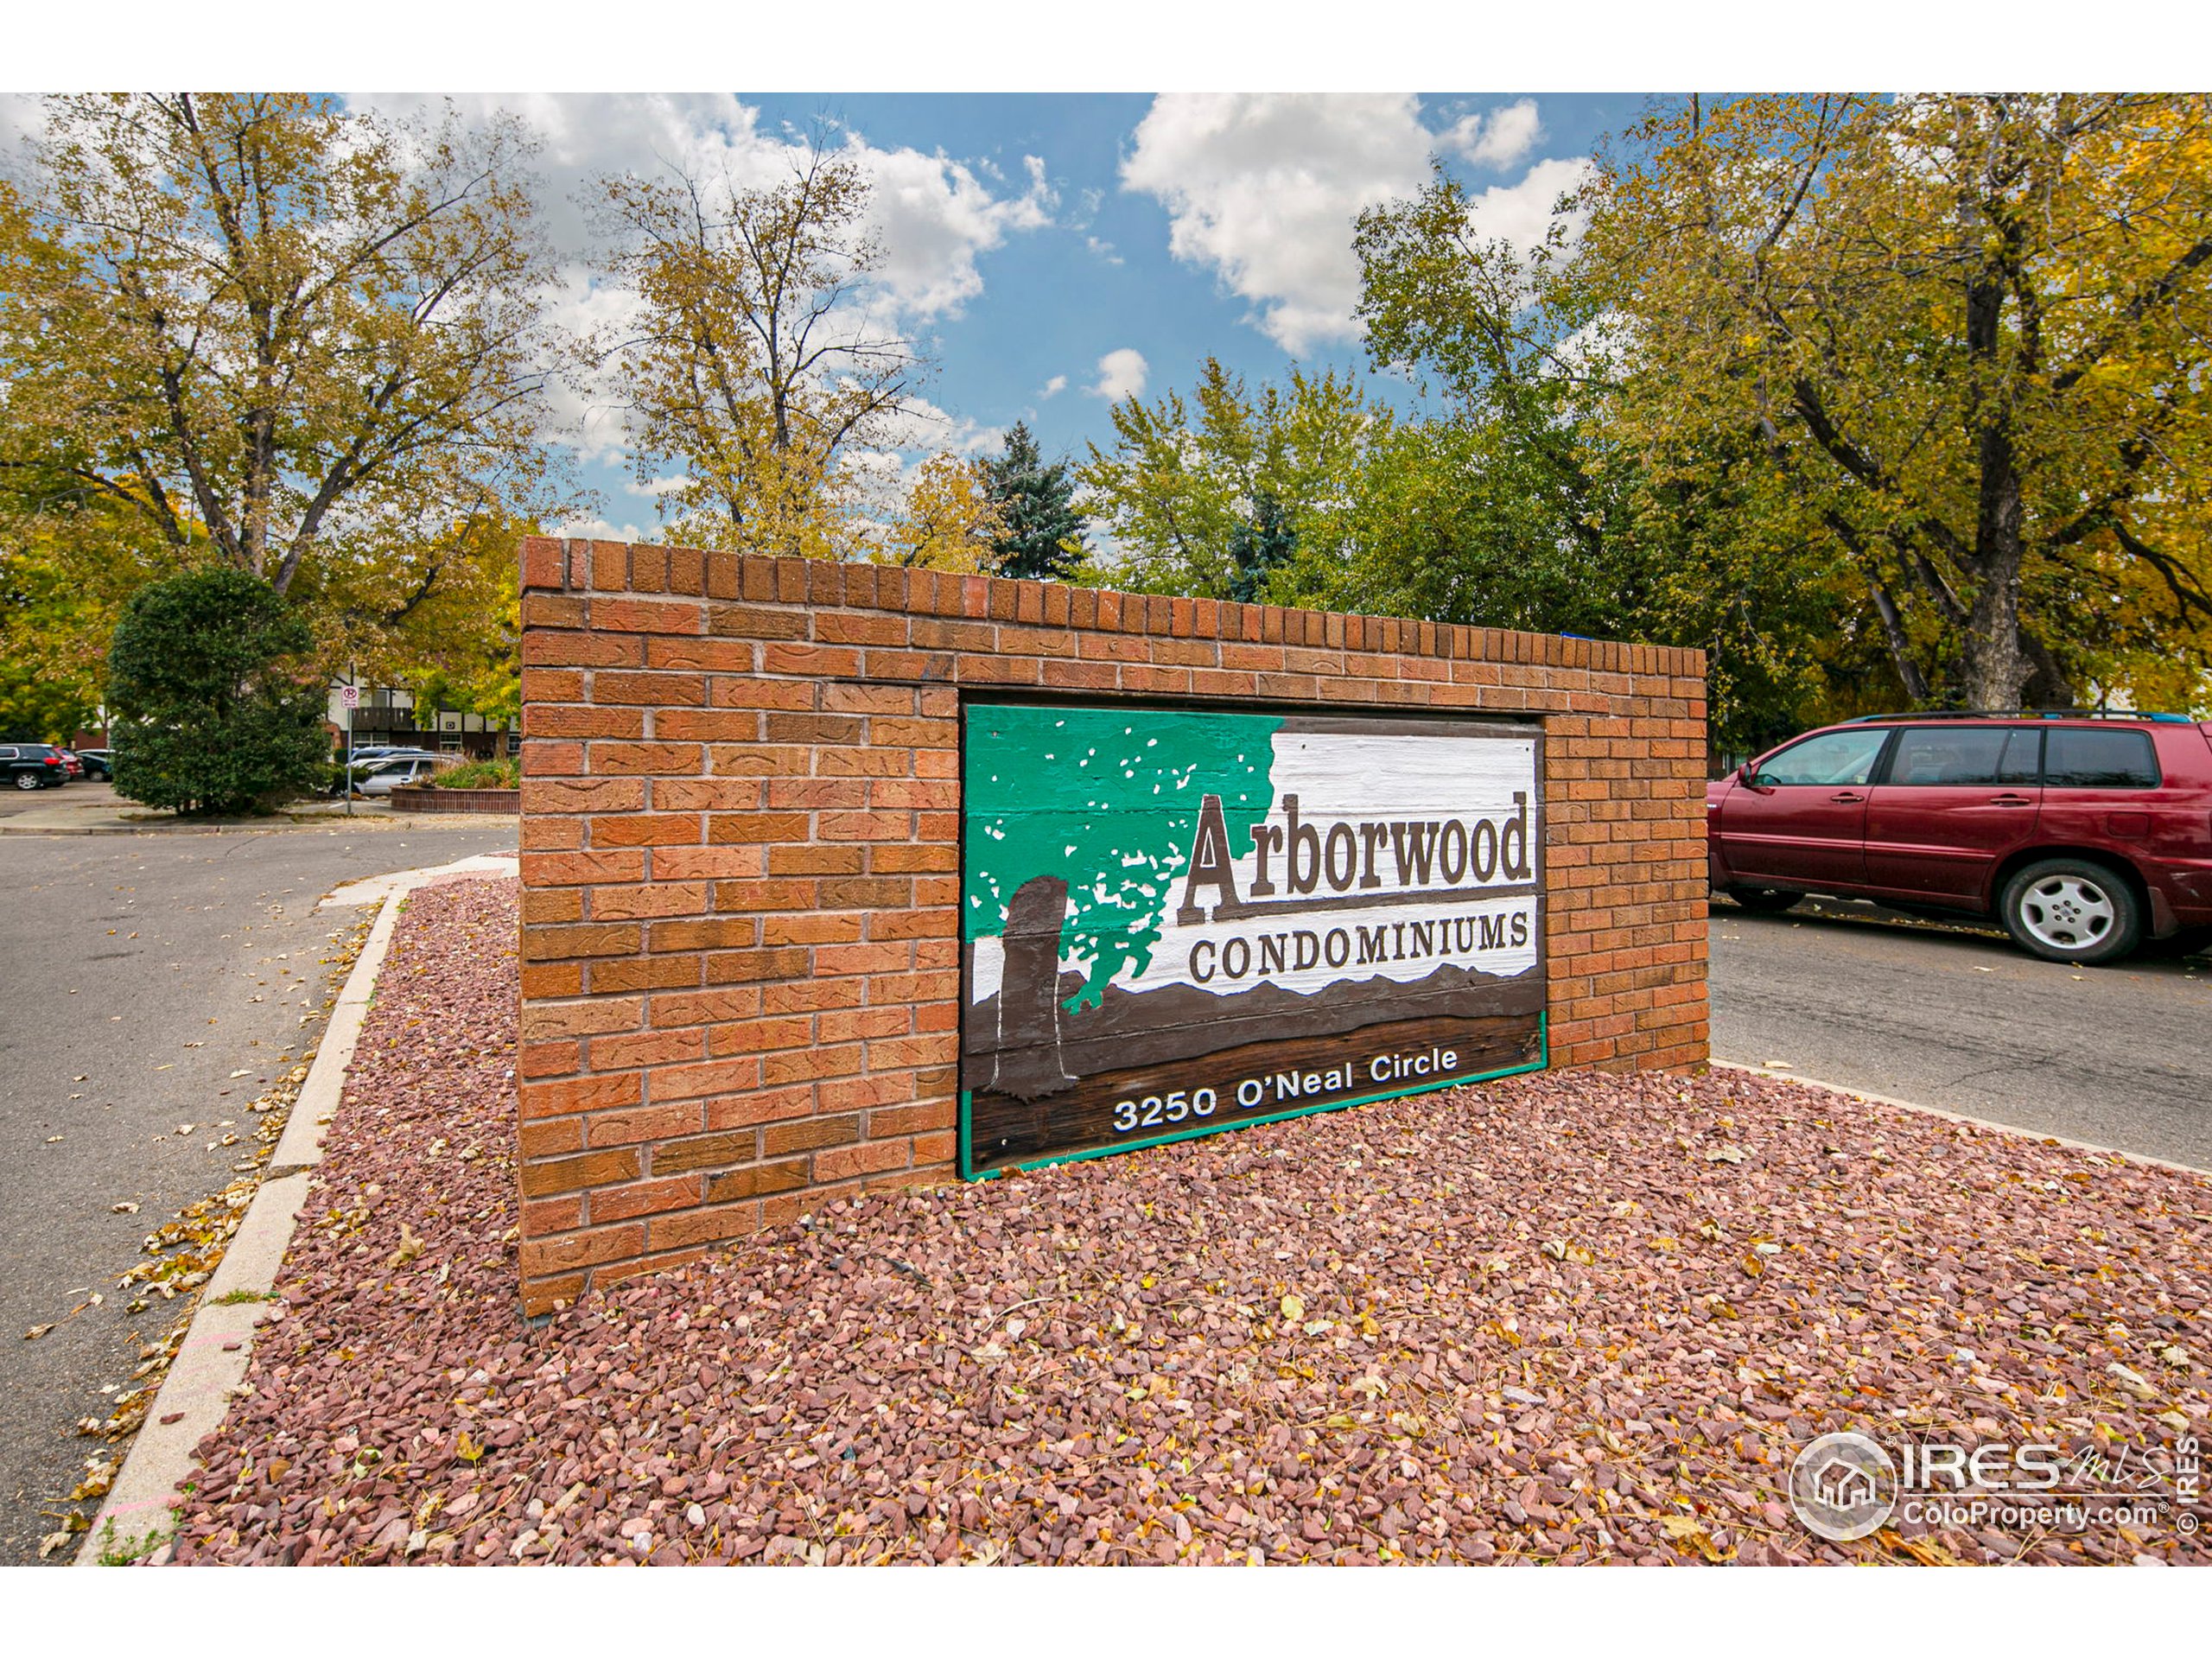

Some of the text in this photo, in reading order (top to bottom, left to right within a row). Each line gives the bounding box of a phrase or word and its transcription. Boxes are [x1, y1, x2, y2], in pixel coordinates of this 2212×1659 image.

[1177, 791, 1532, 926] Arborwood
[1189, 912, 1528, 983] CONDOMINIUMS
[1113, 1048, 1459, 1133] 3250 O'Neal Circle
